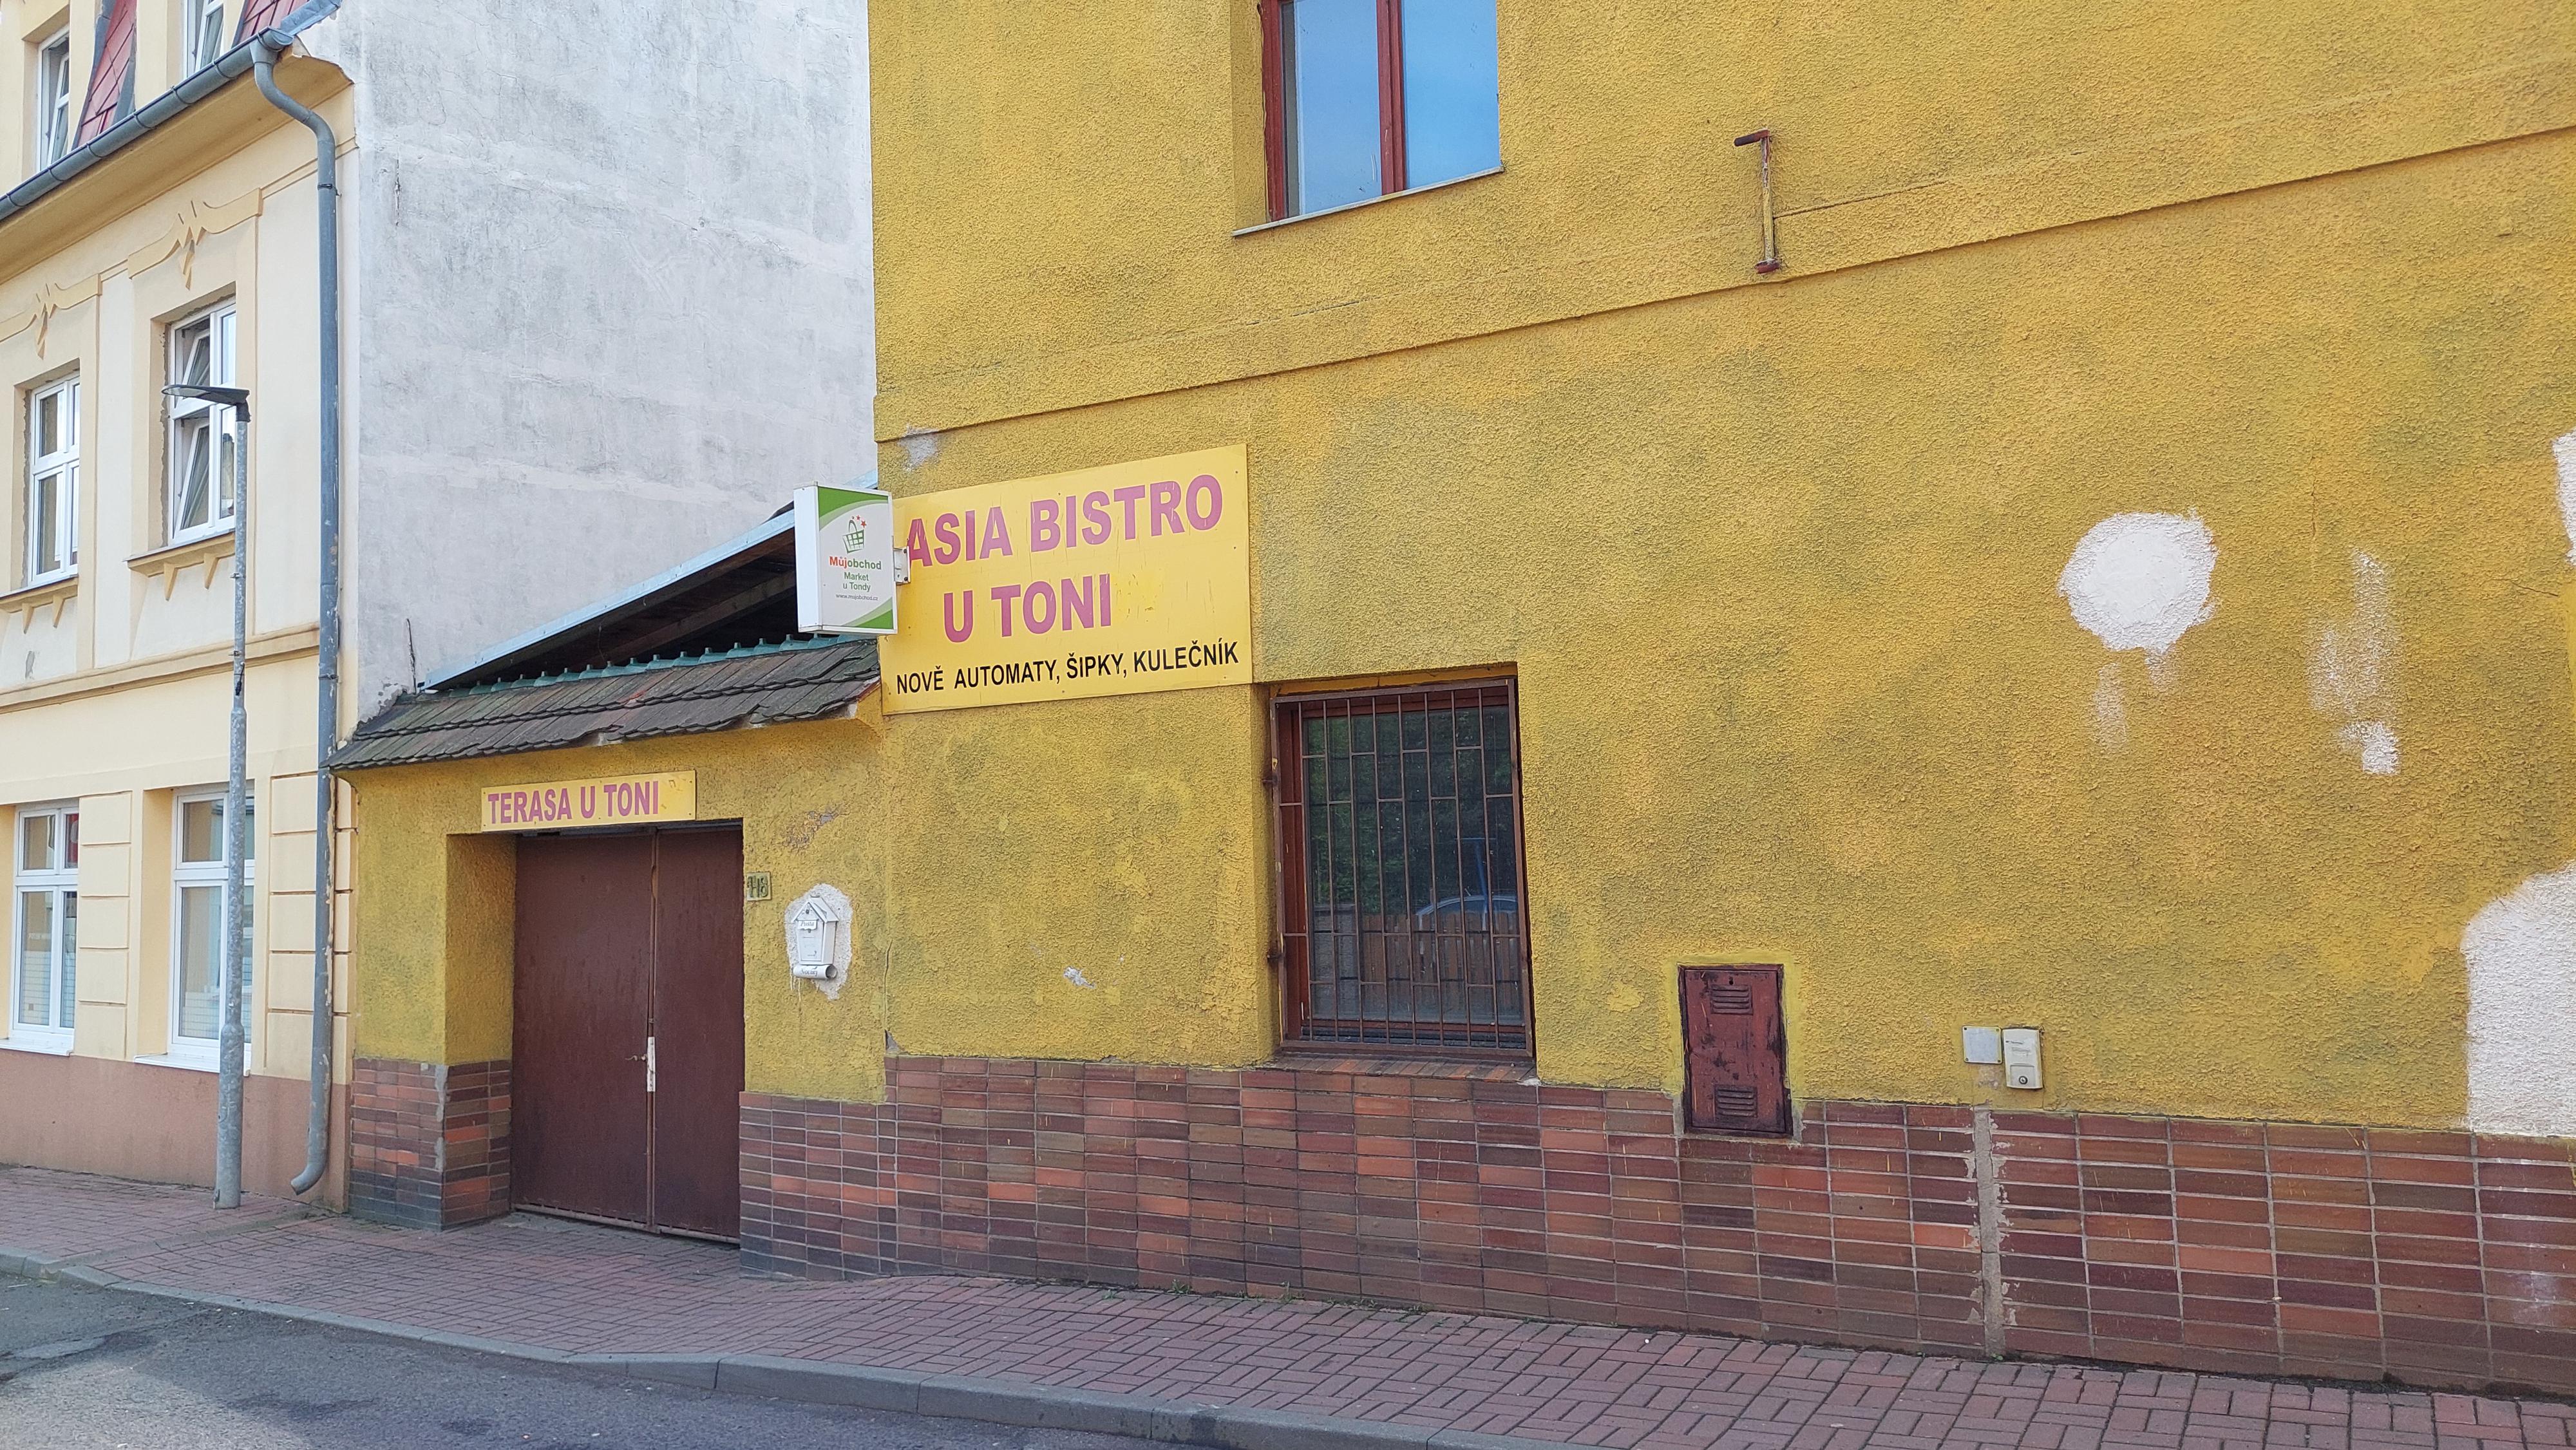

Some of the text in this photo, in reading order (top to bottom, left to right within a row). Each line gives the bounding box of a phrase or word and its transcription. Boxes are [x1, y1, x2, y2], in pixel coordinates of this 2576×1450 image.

[907, 474, 1223, 568] ASIA BISTRO
[829, 556, 882, 570] Můjobchod
[844, 572, 869, 581] Market
[849, 582, 871, 592] Tondy
[943, 573, 1112, 643] U TONI
[896, 637, 1240, 694] NOVĚ AUTOMATY, ŠIPKY, KULEČNÍK
[488, 780, 659, 824] TERASA U TONI
